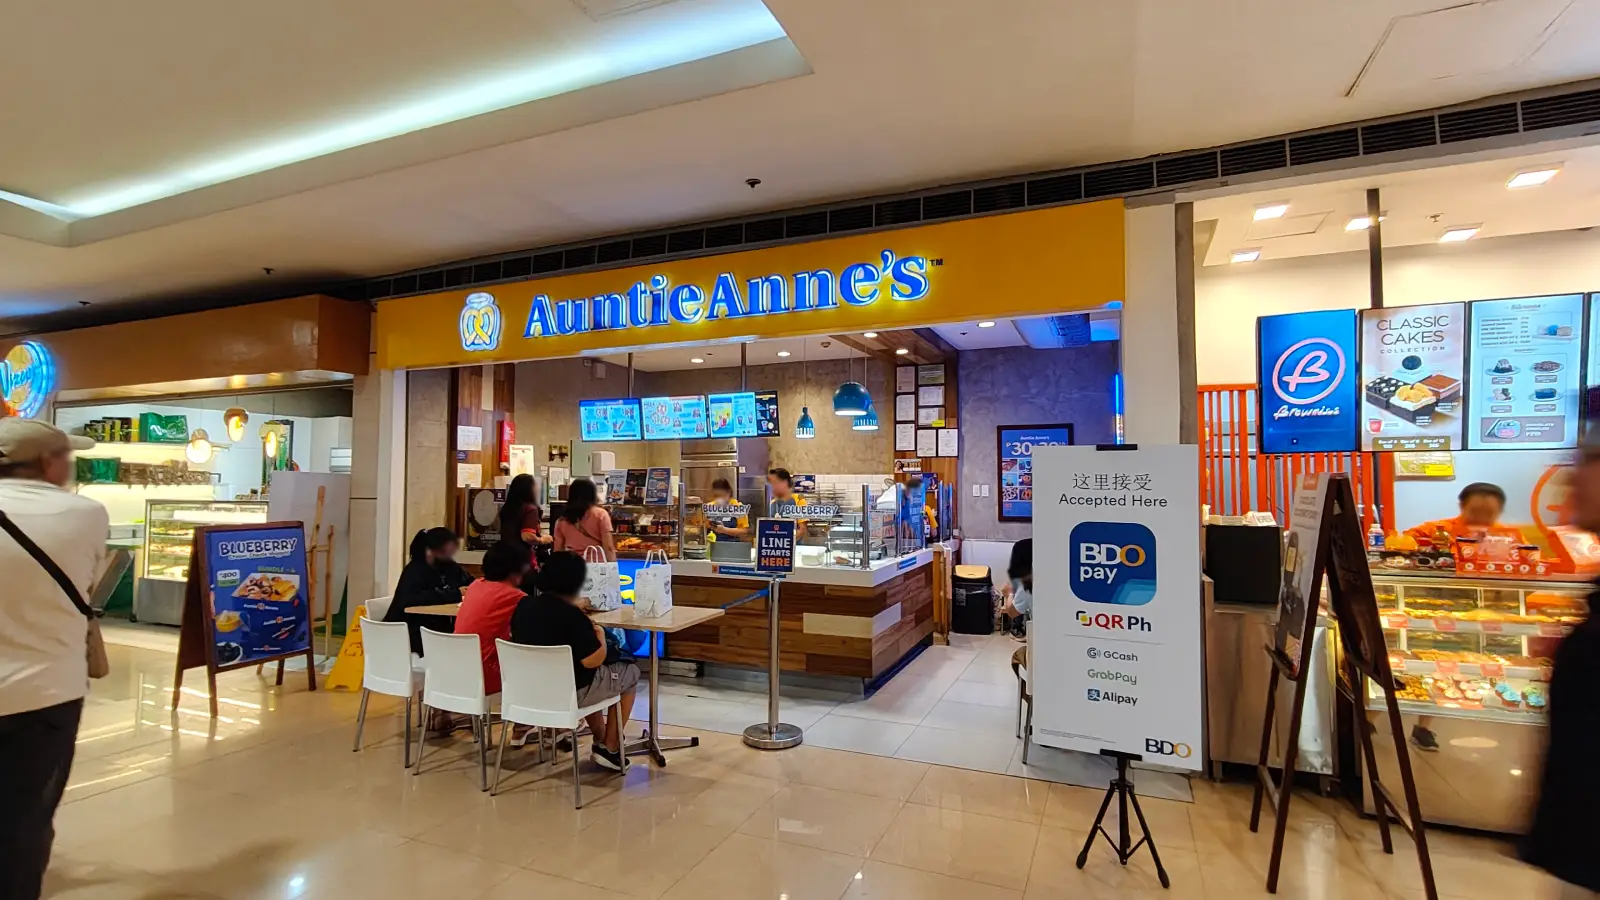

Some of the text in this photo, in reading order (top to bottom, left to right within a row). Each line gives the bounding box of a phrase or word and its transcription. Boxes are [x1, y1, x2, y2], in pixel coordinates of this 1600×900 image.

[1376, 315, 1449, 331] CLASSIC
[1380, 330, 1445, 346] CAKES
[1380, 345, 1445, 355] COLLECTION
[1072, 473, 1153, 491] 这里接受
[1058, 493, 1168, 509] Accepted Here
[702, 504, 751, 515] BLUEBERRY
[784, 504, 839, 515] BLUEBERRY
[220, 538, 298, 555] BLUEBERRY
[762, 537, 791, 548] LINE
[761, 549, 791, 557] STARTS
[1080, 542, 1146, 567] BDO
[761, 557, 790, 567] HERE
[1080, 565, 1118, 584] pay
[1094, 613, 1152, 632] QR Ph
[1103, 650, 1138, 662] GCash
[1087, 668, 1137, 686] GrabPay
[1102, 691, 1138, 707] Alipay
[1145, 737, 1192, 758] BDO
